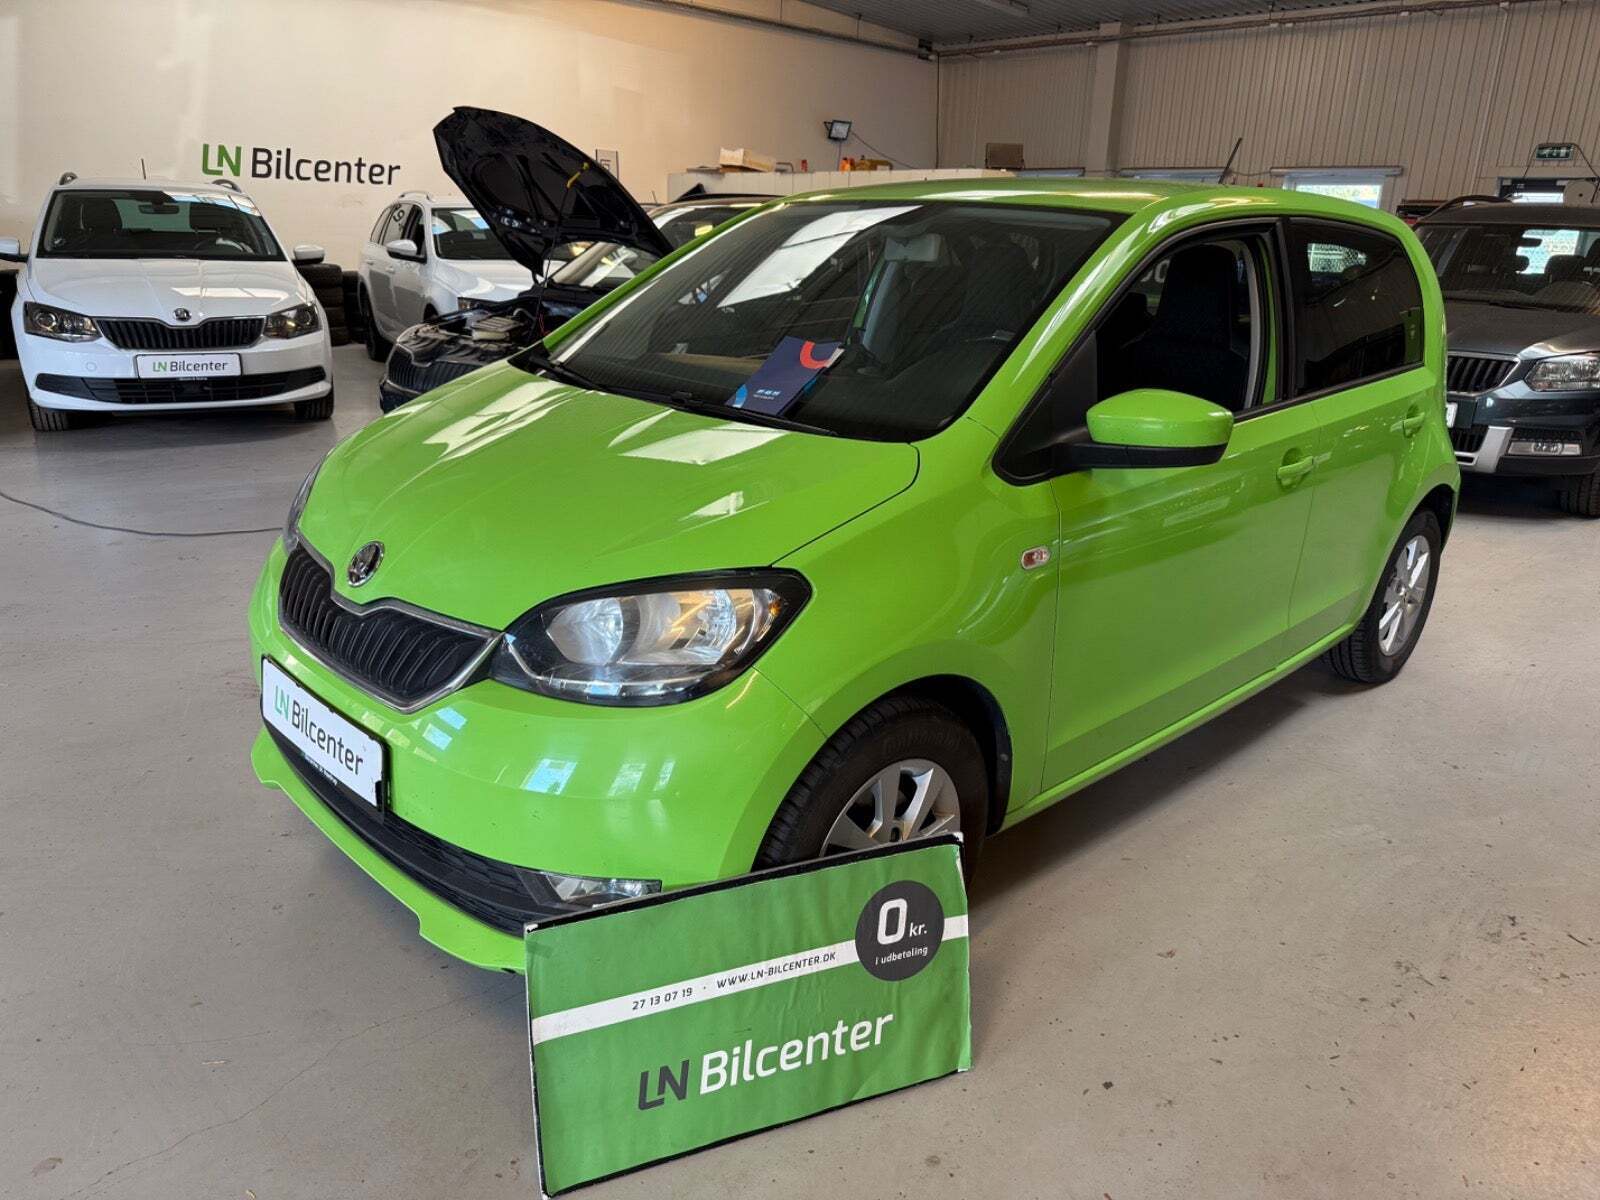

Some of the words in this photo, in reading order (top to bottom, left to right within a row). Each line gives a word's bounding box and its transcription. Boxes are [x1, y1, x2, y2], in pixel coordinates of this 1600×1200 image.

[202, 143, 242, 177] LN
[251, 147, 400, 185] Bilcenter
[153, 361, 167, 372] LN
[170, 361, 228, 372] Bilcenter
[274, 685, 289, 721] LN
[292, 700, 363, 775] Bilcenter
[877, 898, 908, 945] 0
[909, 922, 928, 937] kr.
[881, 946, 928, 964] udbetaling
[632, 1000, 646, 1011] 27
[650, 995, 661, 1006] 13
[664, 990, 678, 1002] 07
[682, 987, 693, 998] 19
[716, 951, 837, 989] WWW.LN-BILCENTER.DK
[638, 1059, 690, 1111] LN
[700, 1014, 893, 1095] Bilcenter
